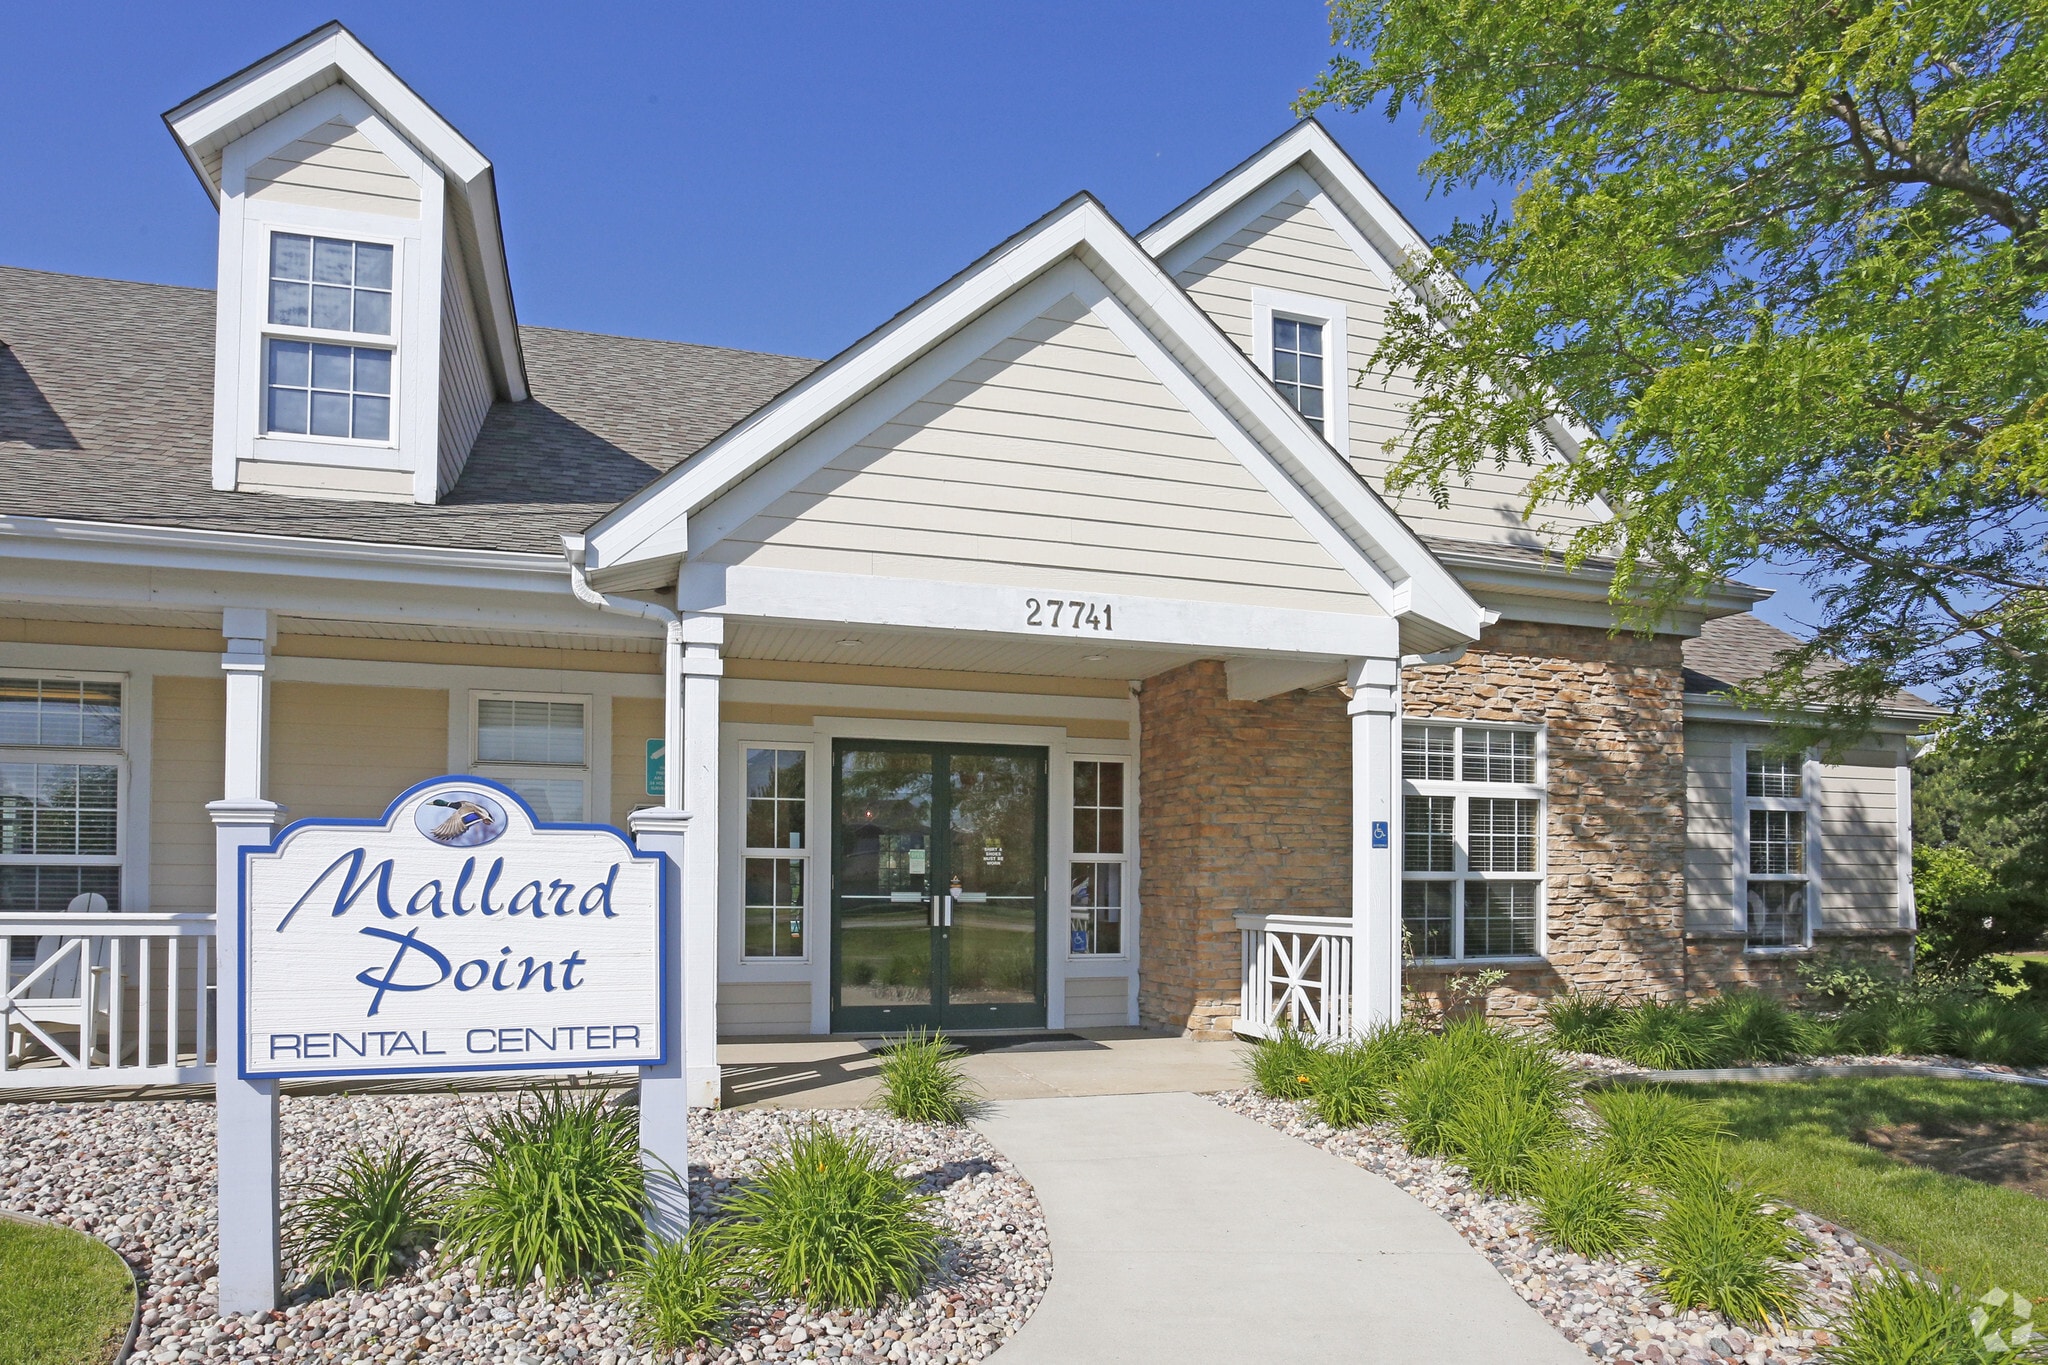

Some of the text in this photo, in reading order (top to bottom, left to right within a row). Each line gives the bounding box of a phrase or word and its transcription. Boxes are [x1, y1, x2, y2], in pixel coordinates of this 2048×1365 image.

[1025, 597, 1113, 631] 27741
[276, 847, 620, 933] Mallard
[356, 926, 587, 1017] Point
[269, 1025, 641, 1060] RENTAL CENTER
